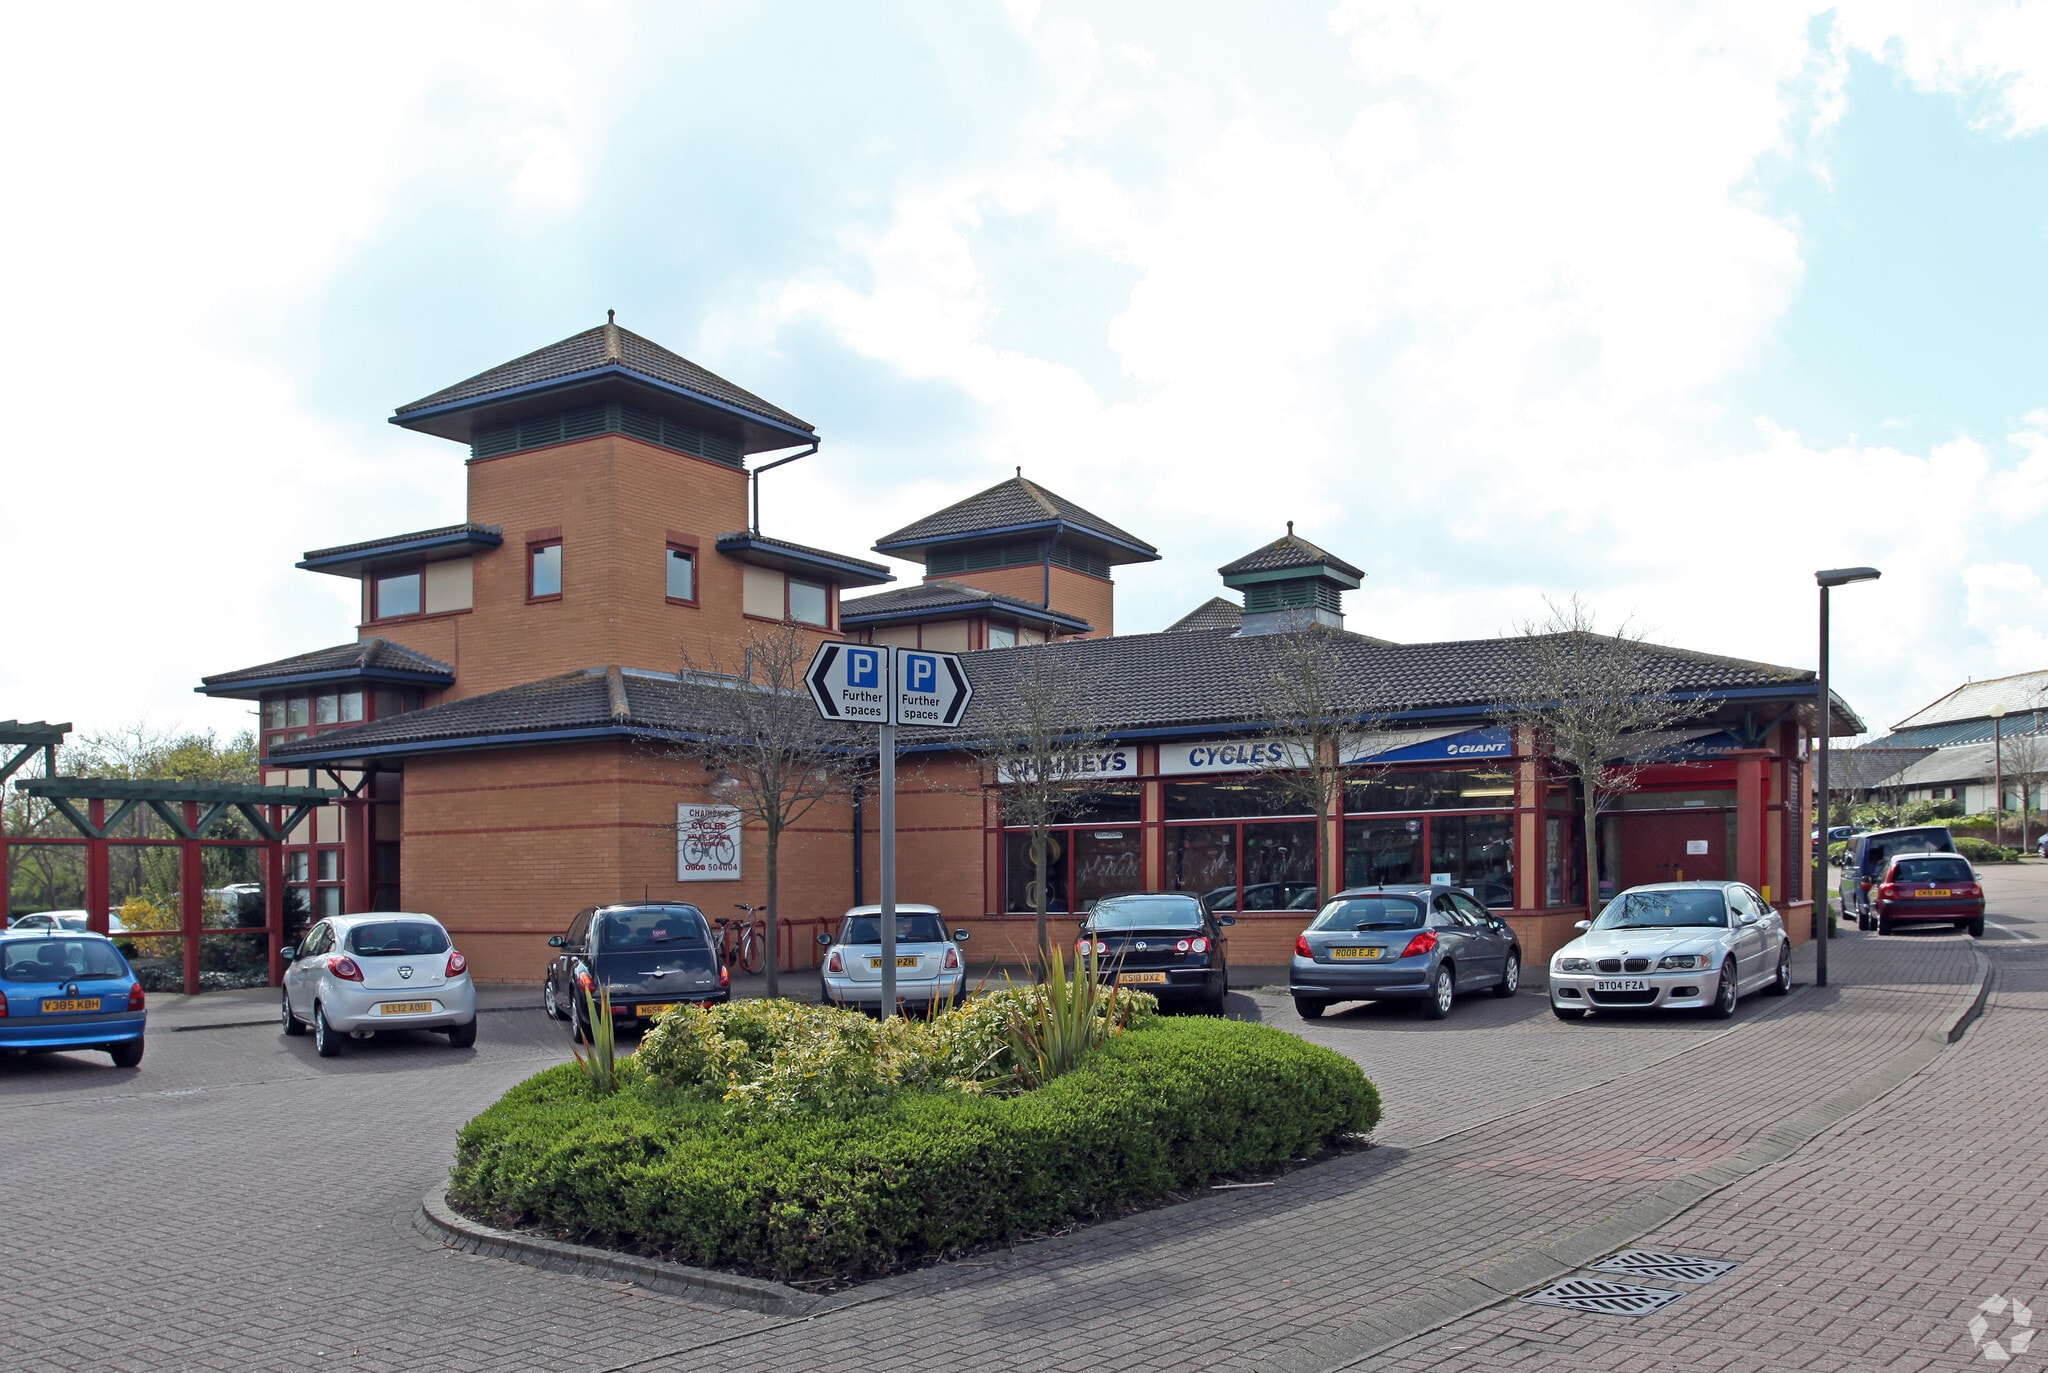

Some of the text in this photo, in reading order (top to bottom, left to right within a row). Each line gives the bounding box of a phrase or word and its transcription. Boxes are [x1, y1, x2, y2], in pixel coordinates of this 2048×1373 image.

[854, 653, 873, 683] P
[913, 659, 932, 688] P
[842, 689, 883, 703] Further
[902, 693, 940, 707] Further
[844, 705, 881, 716] spaces
[904, 709, 939, 720] spaces
[1459, 743, 1506, 754] GIANT
[1706, 745, 1743, 755] GIA
[1189, 742, 1283, 767] CYCLES
[691, 821, 727, 831] CYCLES
[1358, 948, 1376, 957] EJE
[897, 957, 914, 966] PZH
[1143, 973, 1160, 982] DXZ
[1598, 981, 1645, 990] BT04 FZA
[76, 999, 99, 1010] KBH
[386, 1003, 407, 1013] LL12
